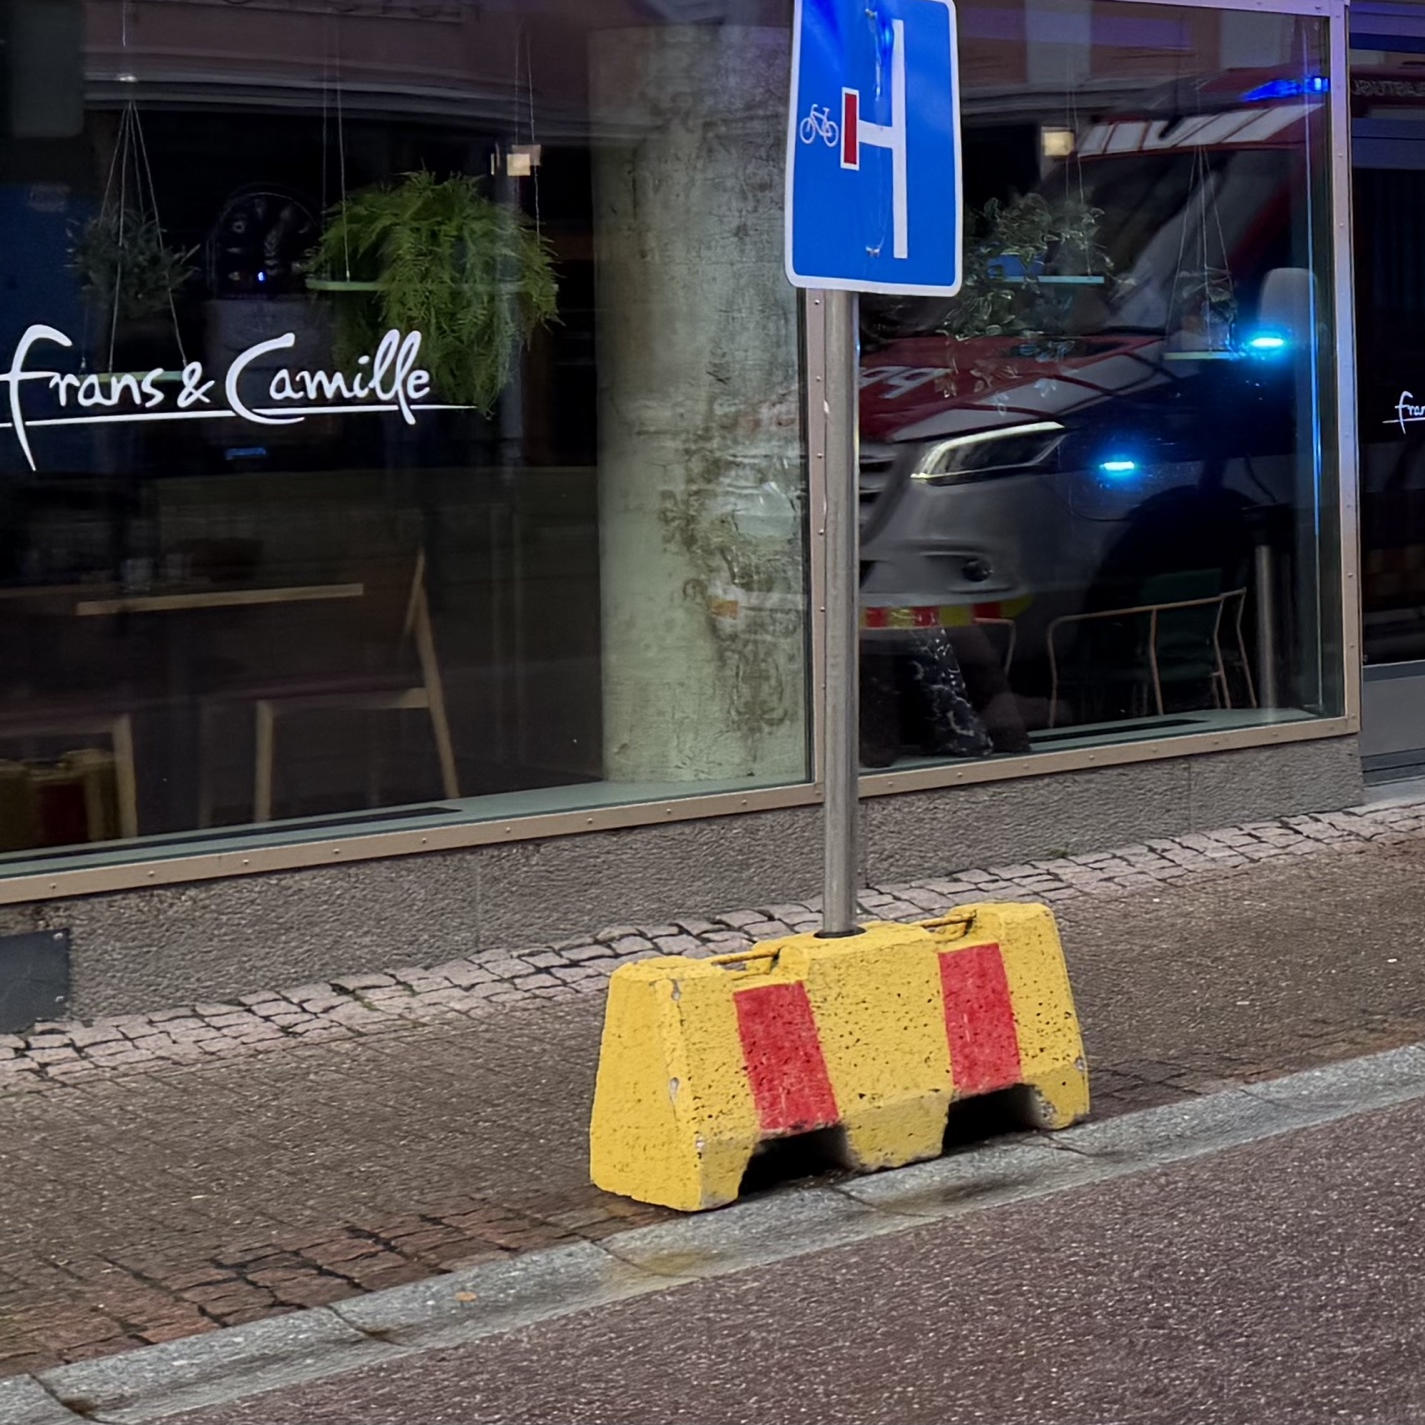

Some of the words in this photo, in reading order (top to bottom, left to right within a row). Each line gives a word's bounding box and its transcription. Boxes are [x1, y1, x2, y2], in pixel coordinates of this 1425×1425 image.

[0, 324, 166, 472] Frans
[176, 361, 216, 409] &
[225, 328, 431, 426] Camille
